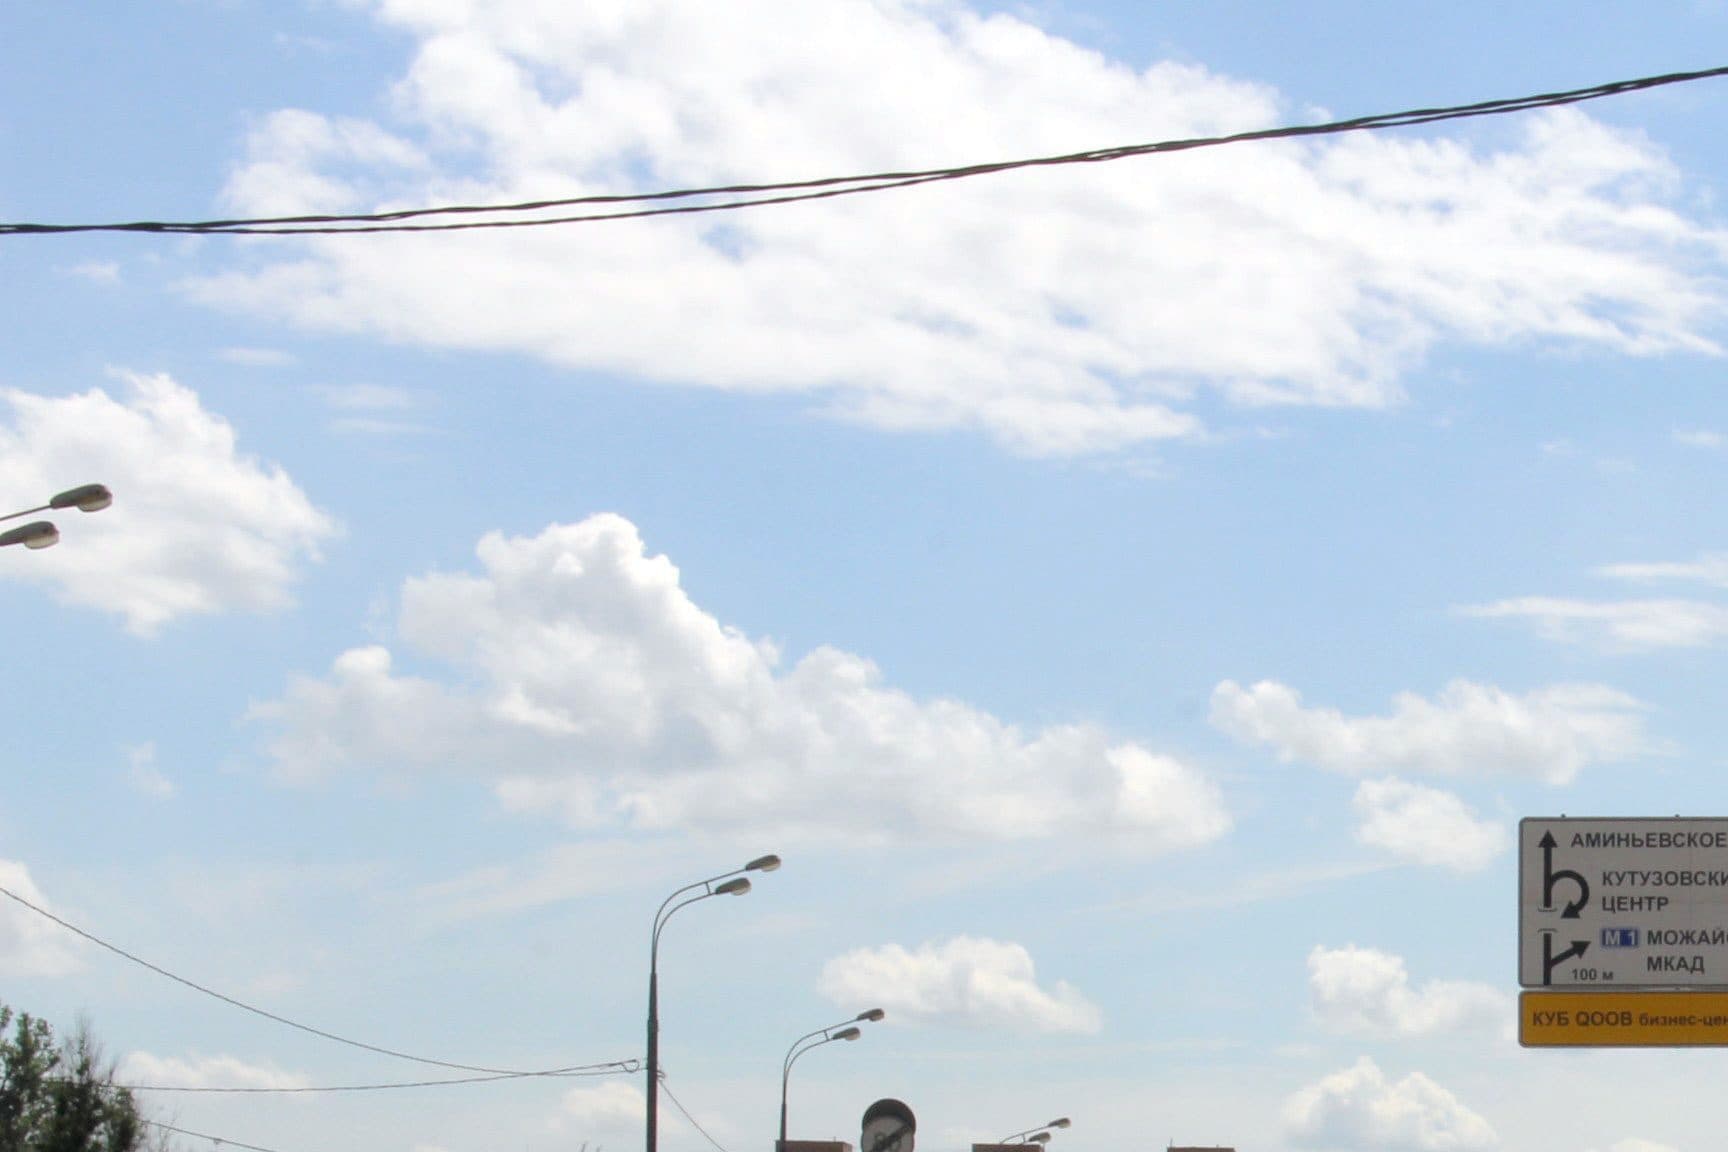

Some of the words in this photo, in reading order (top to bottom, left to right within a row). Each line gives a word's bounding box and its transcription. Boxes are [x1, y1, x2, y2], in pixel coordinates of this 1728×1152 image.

[1570, 832, 1728, 849] АМИНЬЕВСКОЕ
[1602, 897, 1669, 914] ЦЕНТР
[1647, 957, 1705, 974] МКАД
[1572, 968, 1597, 981] 100
[1602, 971, 1614, 981] м
[1532, 1011, 1569, 1026] КУБ
